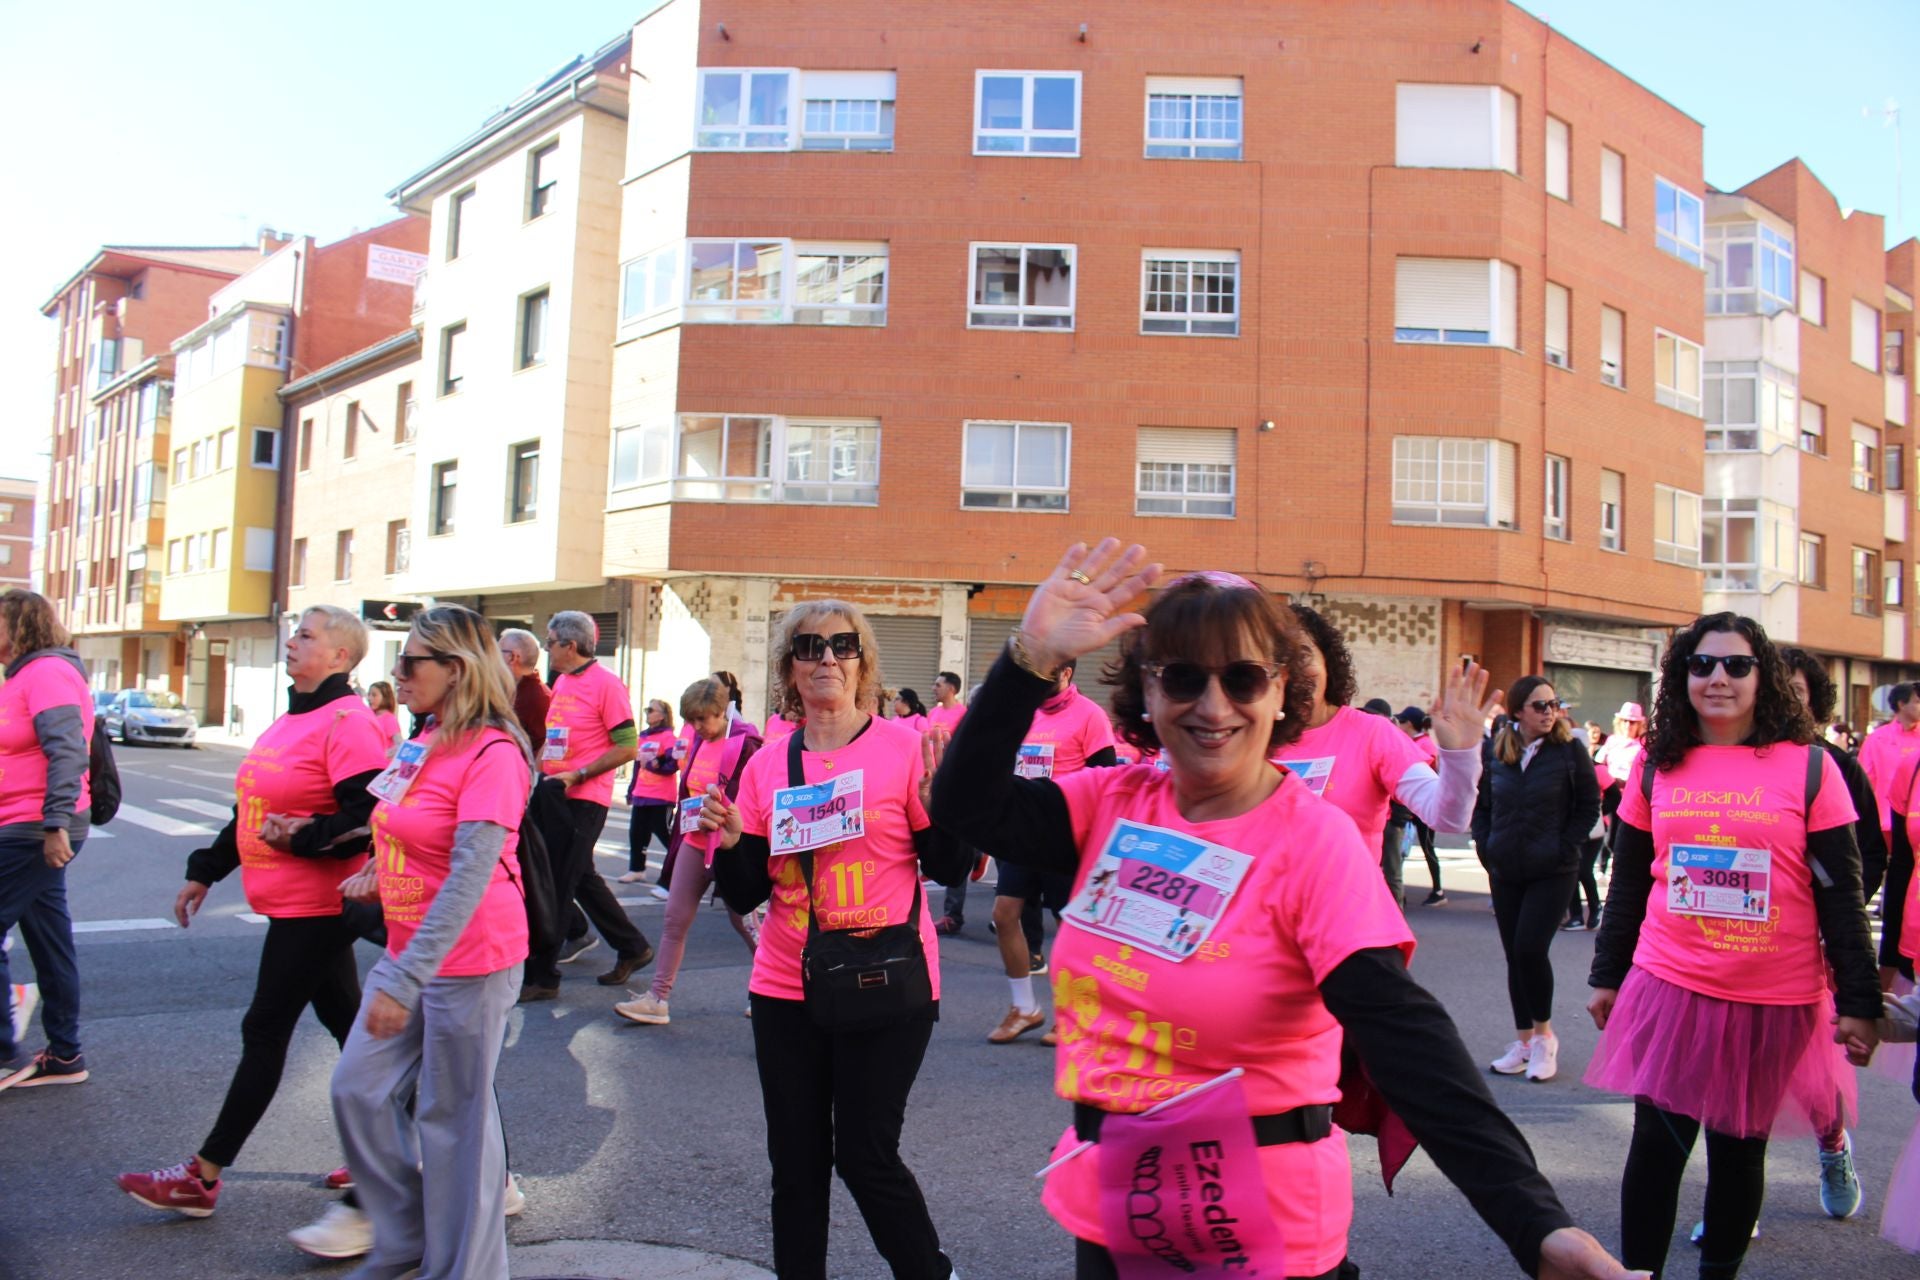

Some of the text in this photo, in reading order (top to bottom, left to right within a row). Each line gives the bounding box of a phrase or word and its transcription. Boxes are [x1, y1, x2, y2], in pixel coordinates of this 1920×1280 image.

[808, 796, 846, 821] 1540
[1726, 808, 1781, 823] CAROBELS
[1695, 834, 1736, 842] SUZUKI
[1130, 866, 1202, 906] 2281
[1703, 869, 1750, 889] 3081
[1693, 890, 1706, 909] 11
[816, 905, 888, 926] Carrera
[1713, 941, 1779, 953] DRASANVI
[1092, 954, 1150, 985] SUZUKI
[1174, 1163, 1192, 1200] Smile
[1189, 1140, 1250, 1270] Ezedent
